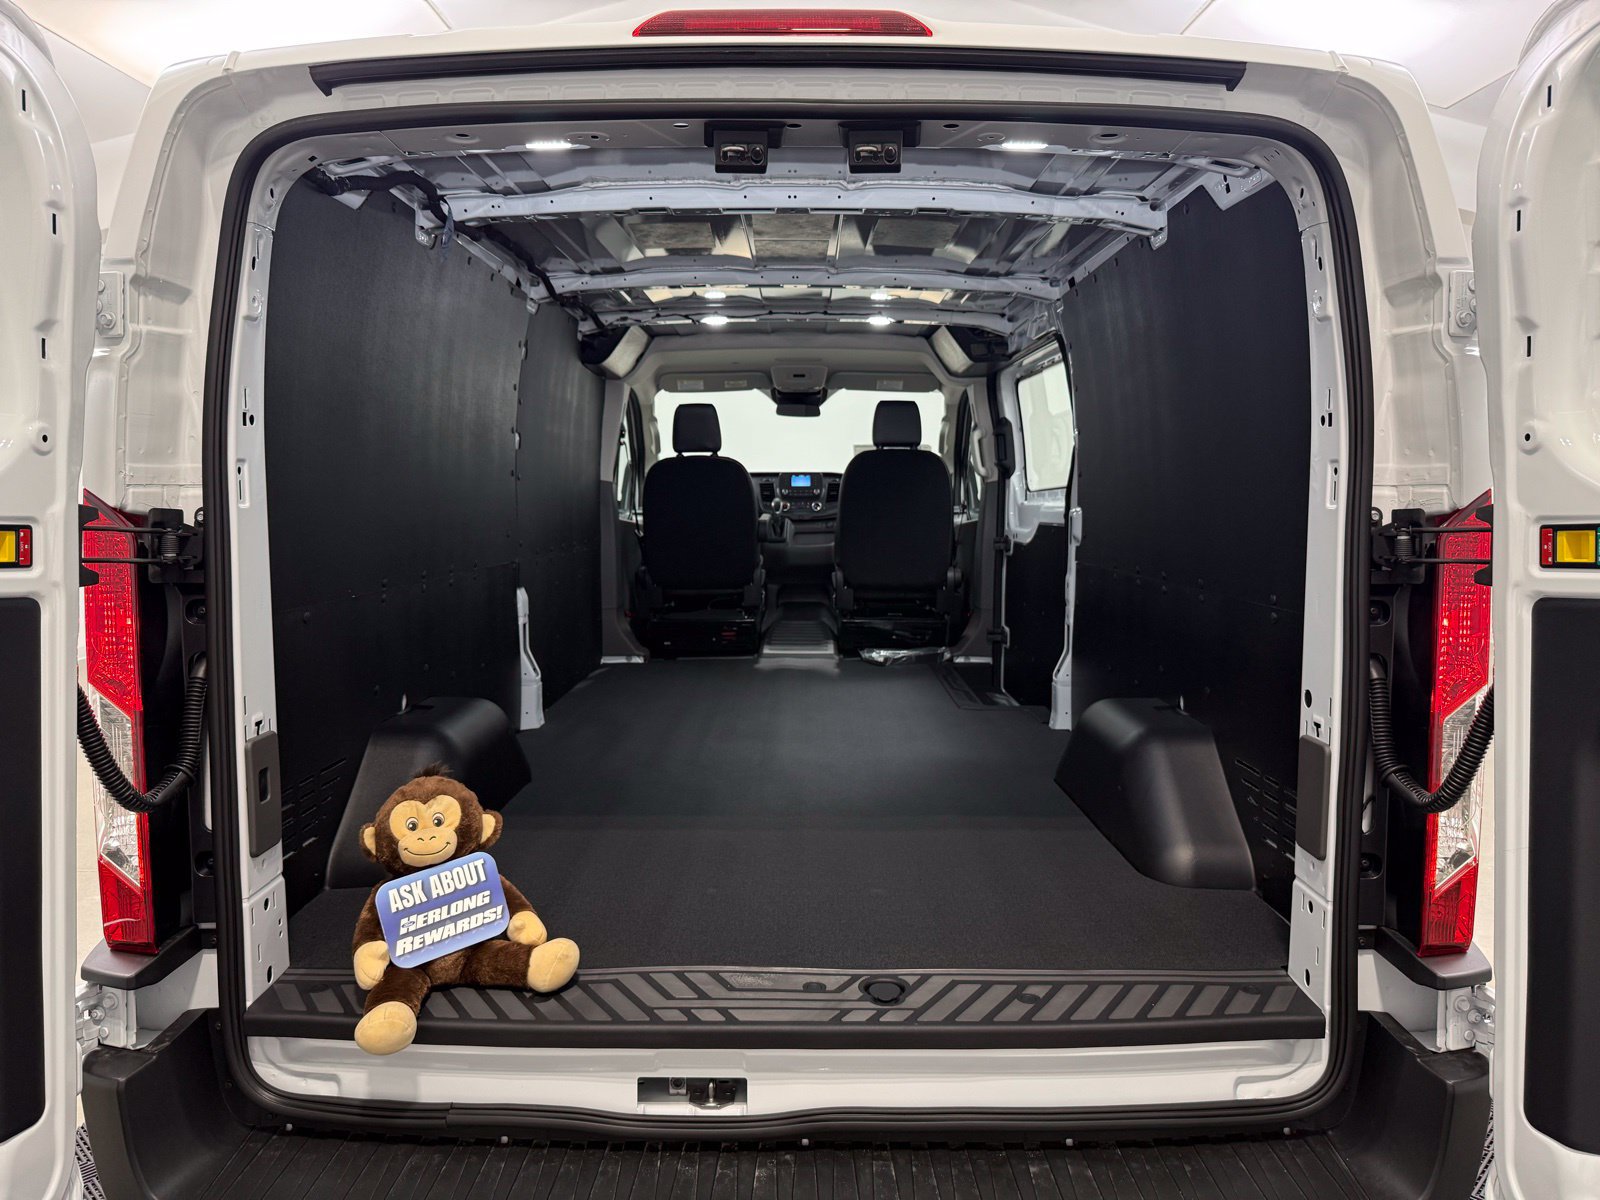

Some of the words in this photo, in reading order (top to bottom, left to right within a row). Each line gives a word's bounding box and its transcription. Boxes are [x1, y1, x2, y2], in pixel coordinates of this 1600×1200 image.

[388, 879, 428, 914] ASK
[429, 858, 487, 899] ABOUT
[395, 905, 503, 957] REWARDS!
[400, 890, 491, 935] HERLONG
